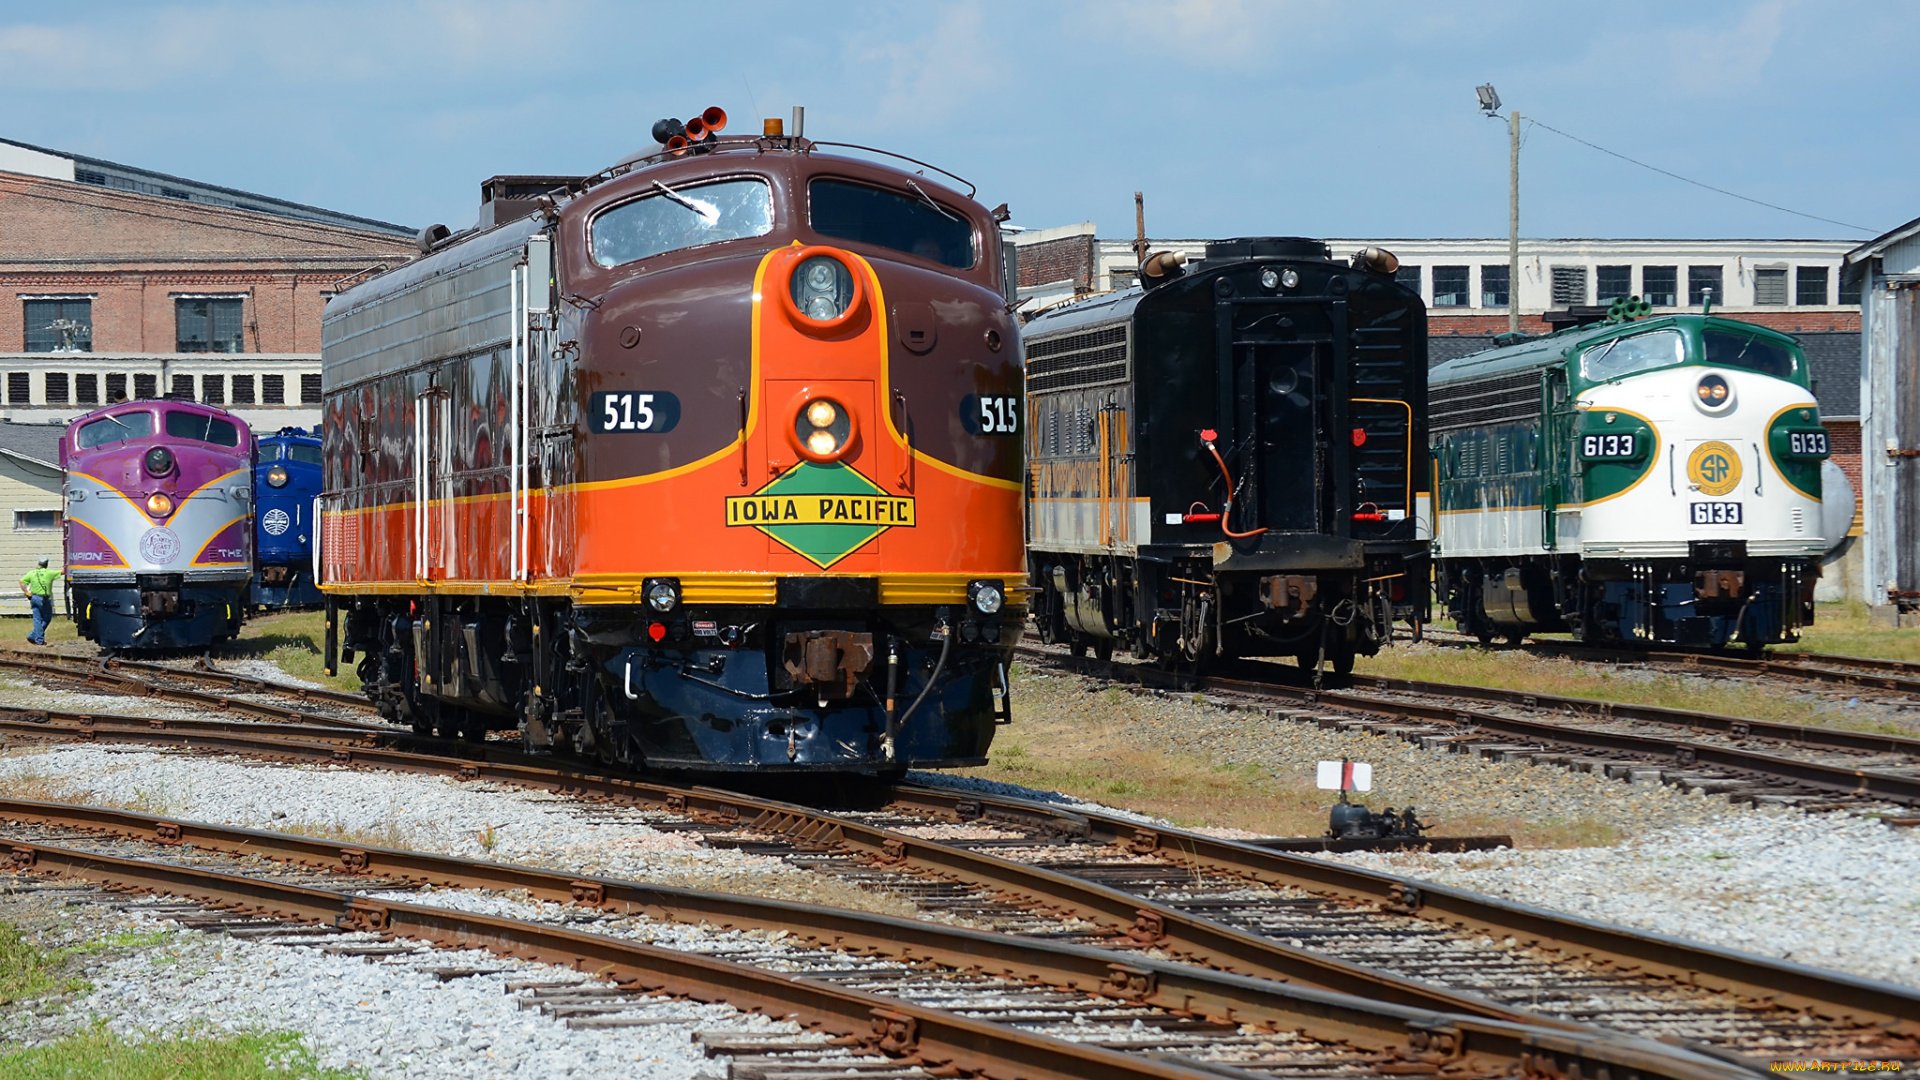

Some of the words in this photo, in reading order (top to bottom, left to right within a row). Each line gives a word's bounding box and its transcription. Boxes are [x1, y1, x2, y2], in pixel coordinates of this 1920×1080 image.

[603, 394, 655, 431] 515
[980, 397, 1017, 433] 515
[1584, 435, 1633, 456] 6133
[1791, 433, 1827, 453] 6133
[1701, 454, 1729, 482] SR
[732, 500, 798, 521] IOWA
[819, 499, 909, 522] PACIFIC
[1694, 503, 1739, 523] 6133
[218, 548, 243, 558] THE
